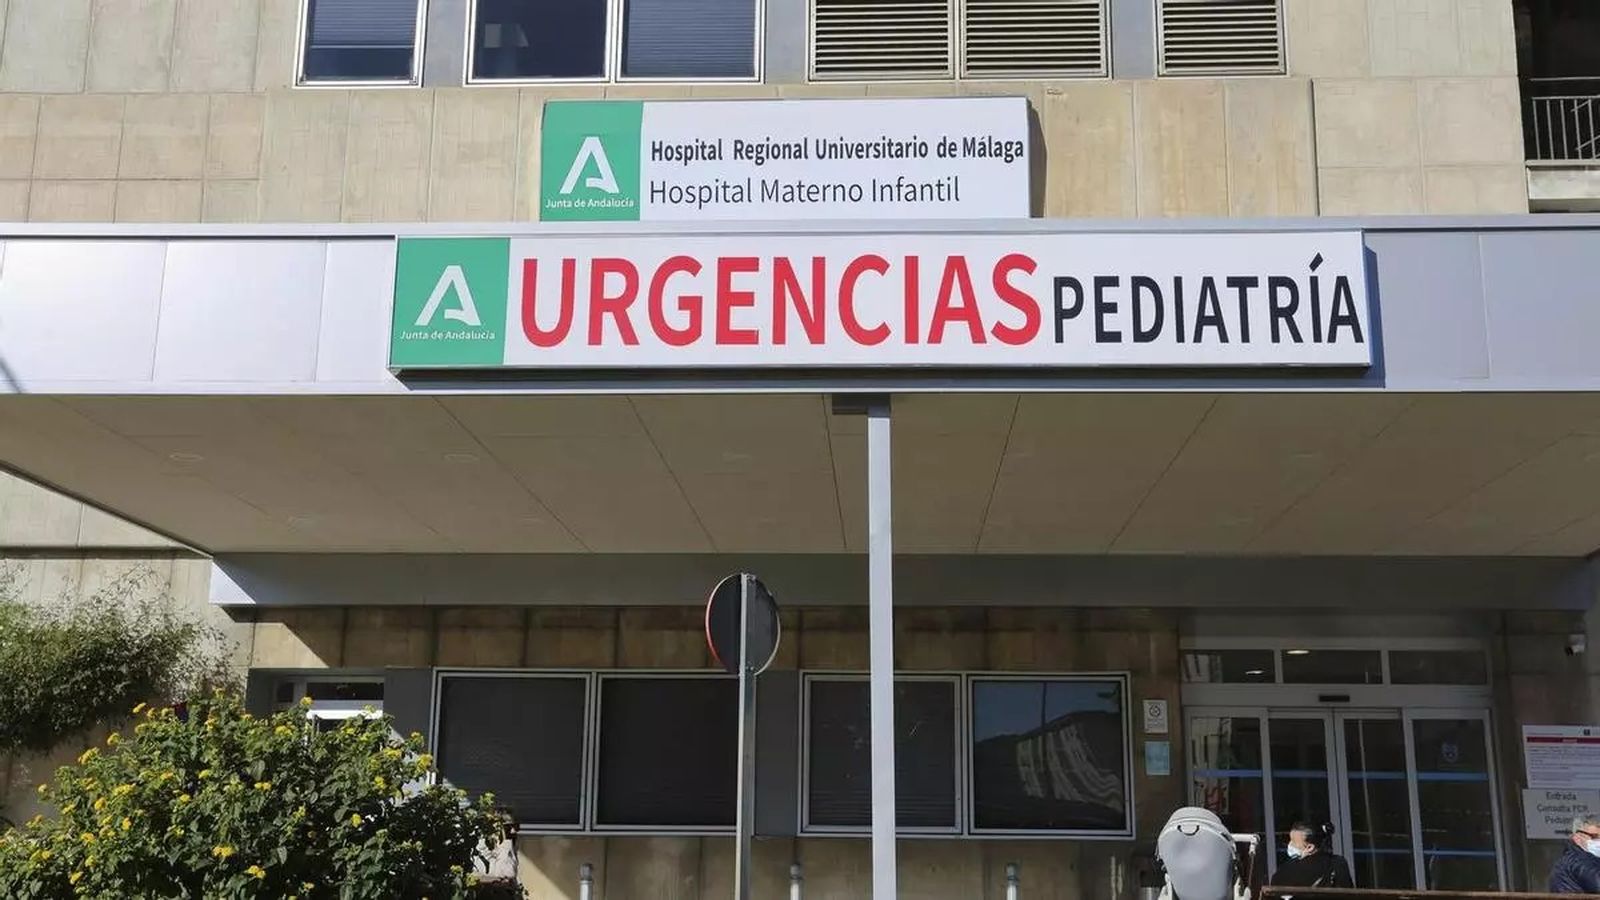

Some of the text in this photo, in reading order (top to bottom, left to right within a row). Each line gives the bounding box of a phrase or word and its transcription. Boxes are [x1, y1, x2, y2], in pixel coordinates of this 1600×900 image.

[651, 135, 1024, 167] Hospital Regional Universitario de Málaga
[545, 197, 635, 209] Junta de Andalucía
[650, 175, 960, 210] Hospital Materno Infantil
[521, 252, 1364, 349] URGENCIAS PEDIATRÍA
[400, 330, 496, 340] Junta de Andalucía
